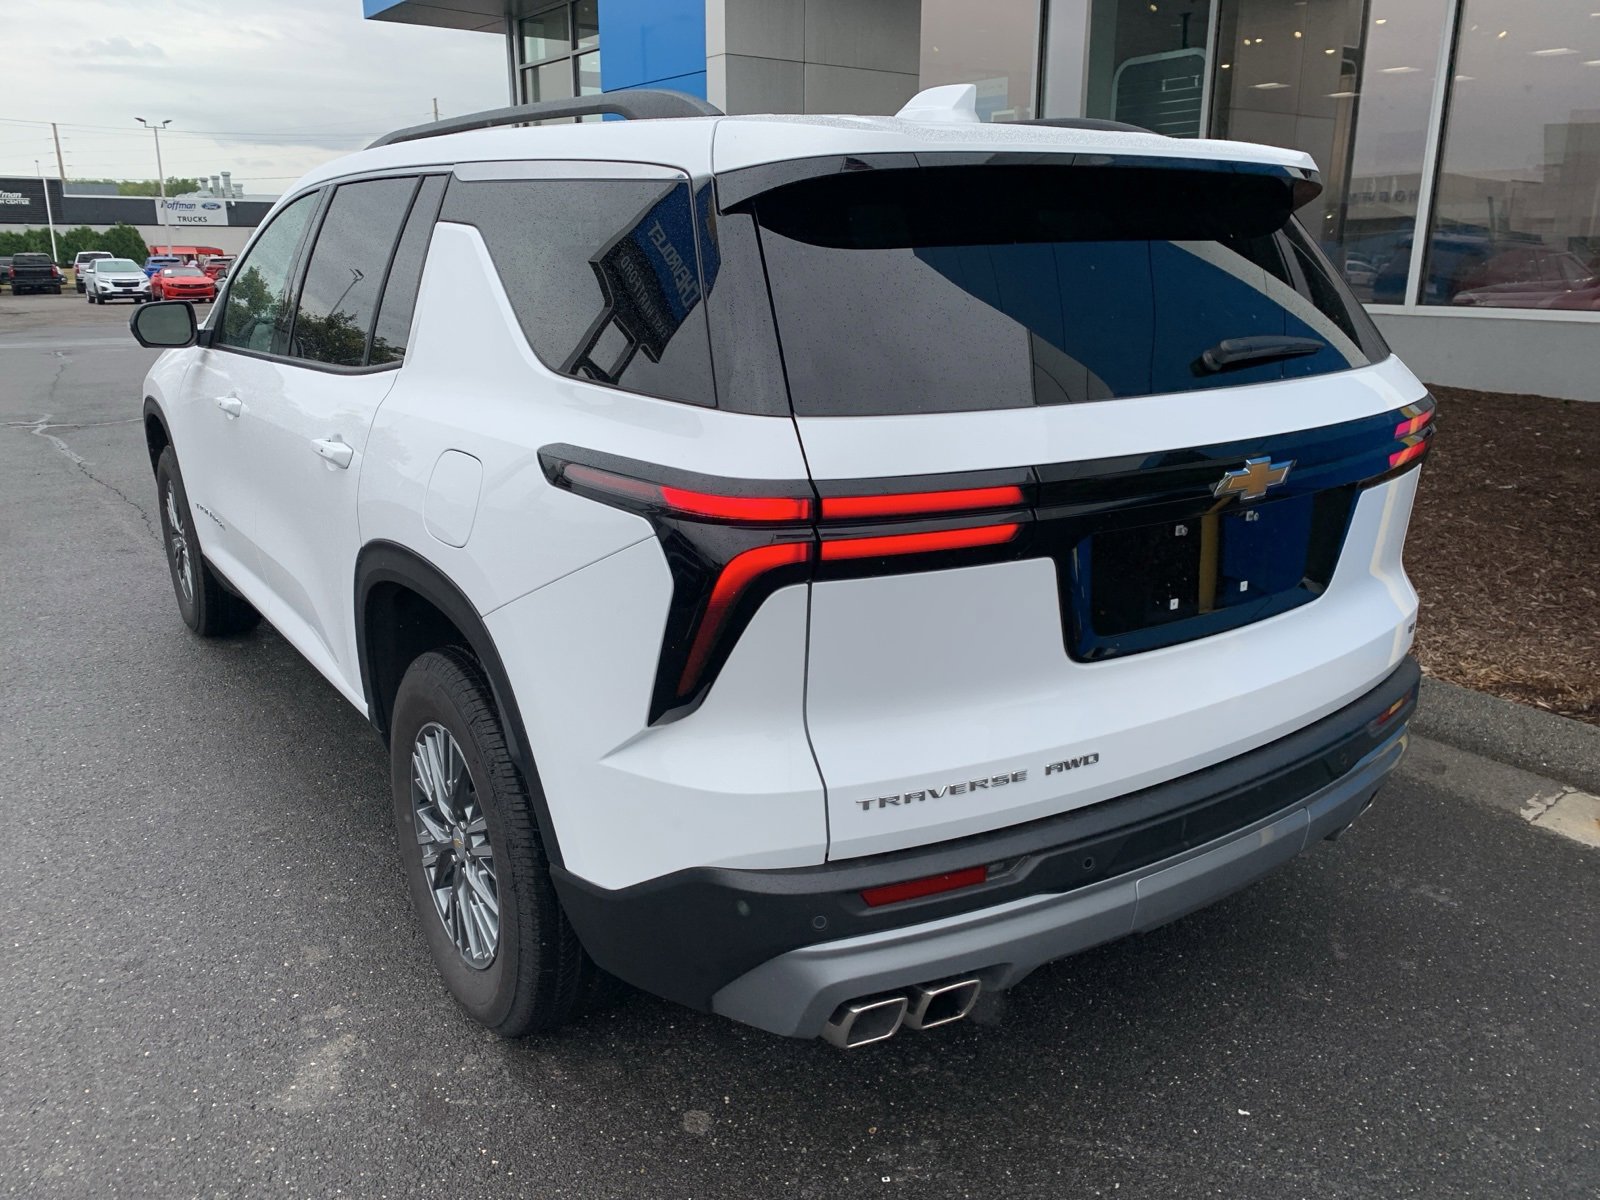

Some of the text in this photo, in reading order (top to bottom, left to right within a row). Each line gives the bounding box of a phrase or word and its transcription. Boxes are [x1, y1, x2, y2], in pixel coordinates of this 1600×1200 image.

[0, 190, 22, 199] man
[856, 752, 1100, 811] TRAVERSE AWD
